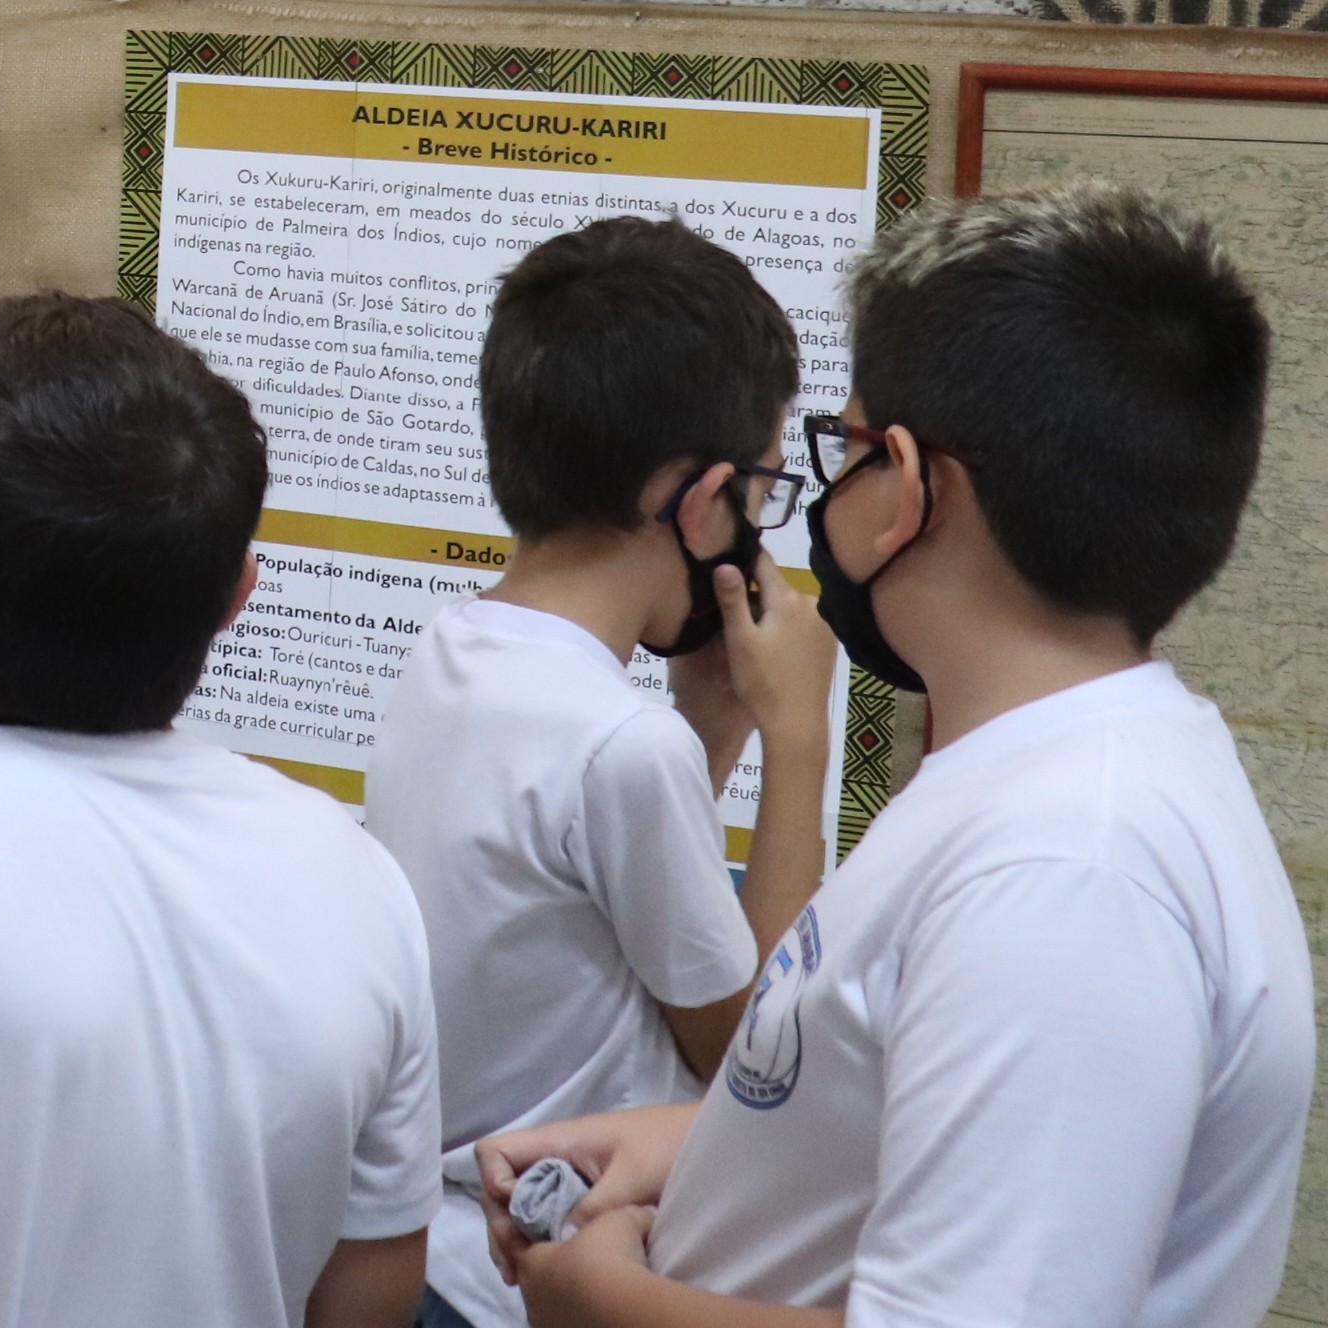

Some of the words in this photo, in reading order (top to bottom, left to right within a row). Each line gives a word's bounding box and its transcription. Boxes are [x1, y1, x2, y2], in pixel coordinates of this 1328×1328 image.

[352, 106, 448, 128] ALDEIA
[456, 111, 667, 141] XUCURU-KARIRI
[418, 138, 482, 159] Breve
[492, 141, 597, 166] Histórico
[237, 170, 260, 185] Os
[265, 171, 378, 194] Xukuru-Kariri,
[382, 181, 492, 201] originalmente
[498, 187, 535, 204] duas
[541, 192, 588, 207] etnias
[596, 193, 665, 213] distintas,
[685, 199, 715, 215] dos
[723, 200, 787, 220] Xucuru
[793, 209, 804, 221] e
[809, 210, 818, 222] a
[826, 208, 857, 224] dos
[175, 213, 247, 232] município
[256, 216, 274, 232] de
[283, 220, 348, 238] Palmeira
[357, 223, 385, 240] dos
[394, 222, 445, 246] Índios,
[452, 232, 486, 251] cujo
[176, 188, 222, 206] Kariri,
[230, 194, 245, 206] se
[254, 195, 369, 217] estabeleceram,
[376, 205, 400, 218] em
[409, 205, 471, 223] meados
[481, 209, 502, 225] do
[512, 212, 563, 228] século
[725, 225, 745, 241] de
[753, 227, 824, 249] Alagoas,
[833, 235, 855, 249] no
[174, 234, 241, 254] indígenas
[245, 241, 261, 254] na
[266, 240, 316, 261] região.
[233, 261, 281, 279] Como
[287, 264, 324, 283] havia
[331, 269, 383, 288] muitos
[389, 272, 462, 294] conflitos,
[172, 277, 238, 298] Warcanã
[245, 283, 263, 300] de
[268, 286, 324, 305] Aruanã
[332, 290, 356, 310] (Sr.
[361, 294, 393, 312] José
[401, 297, 447, 316] Sátiro
[455, 301, 476, 318] do
[171, 301, 236, 320] Nacional
[240, 306, 259, 322] do
[263, 305, 304, 328] Índio,
[306, 316, 330, 330] em
[334, 315, 392, 336] Brasília,
[393, 324, 403, 335] e
[406, 324, 474, 343] solicitou
[811, 361, 848, 374] para
[201, 327, 222, 342] ele
[226, 332, 242, 344] se
[246, 333, 310, 350] mudasse
[315, 340, 348, 353] com
[352, 343, 376, 356] sua
[381, 343, 434, 363] família,
[237, 355, 253, 367] na
[259, 356, 305, 374] região
[310, 360, 328, 374] de
[334, 362, 376, 379] Paulo
[379, 366, 438, 387] Afonso,
[253, 377, 345, 399] dificuldades.
[350, 387, 401, 404] Diante
[407, 392, 451, 411] disso,
[456, 399, 464, 410] a
[261, 402, 334, 422] município
[341, 407, 359, 423] de
[367, 408, 394, 426] São
[402, 413, 474, 437] Gotardo,
[268, 426, 310, 443] terra,
[313, 428, 332, 443] de
[337, 431, 375, 448] onde
[380, 437, 421, 453] tiram
[426, 442, 452, 457] seu
[266, 449, 338, 469] município
[341, 453, 359, 470] de
[363, 456, 418, 478] Caldas,
[420, 464, 440, 480] no
[444, 464, 467, 483] Sul
[471, 467, 490, 484] de
[296, 474, 313, 488] os
[316, 473, 360, 494] índios
[364, 481, 380, 495] se
[383, 483, 474, 507] adaptassem
[477, 490, 486, 507] à
[256, 553, 343, 579] População
[348, 564, 423, 589] indígena
[287, 626, 353, 650] Ouricuri
[355, 613, 376, 628] da
[211, 641, 262, 660] típica:
[270, 646, 304, 665] Toré
[309, 651, 362, 676] (cantos
[366, 664, 375, 675] e
[212, 663, 267, 683] oficial:
[269, 670, 374, 700] Ruaynyn'rêuê.
[220, 686, 242, 703] Na
[246, 689, 289, 710] aldeia
[294, 698, 339, 717] existe
[343, 708, 376, 723] uma
[214, 708, 231, 724] da
[235, 712, 276, 731] grade
[280, 718, 354, 744] curricular
